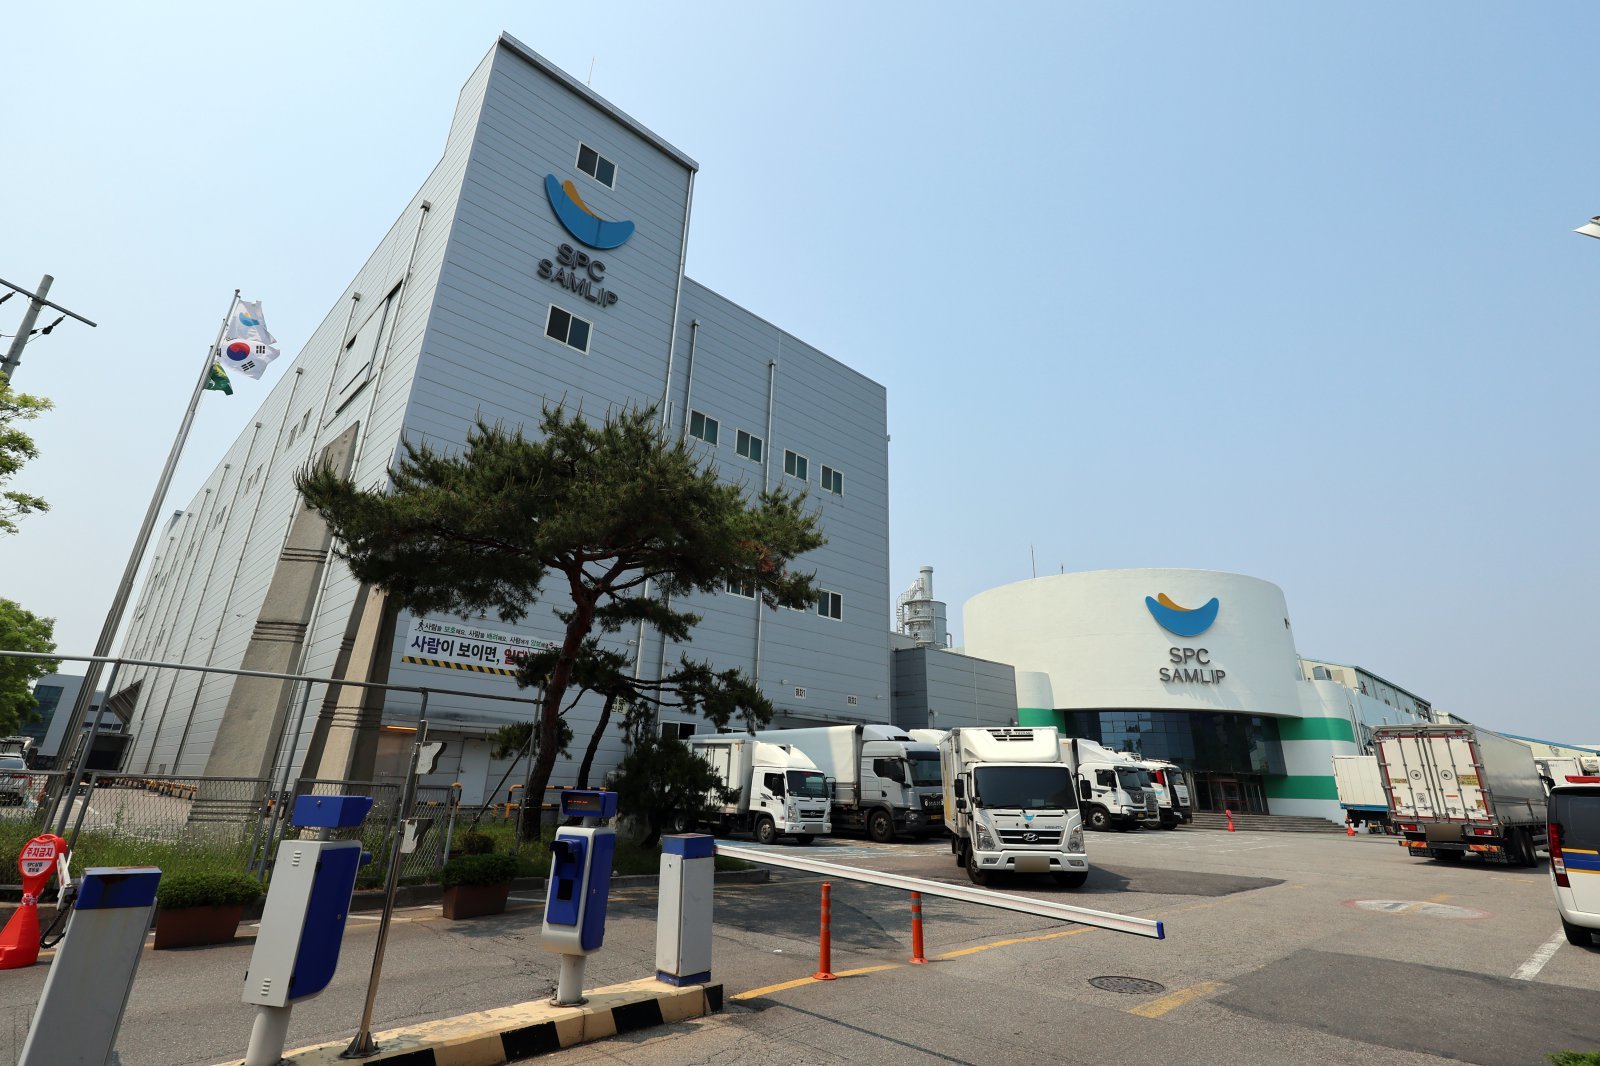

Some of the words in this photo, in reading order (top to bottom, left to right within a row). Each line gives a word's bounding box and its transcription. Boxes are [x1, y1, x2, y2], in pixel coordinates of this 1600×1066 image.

[557, 243, 606, 282] SPC
[537, 258, 618, 308] SAMLIP
[424, 622, 442, 631] 사람을
[468, 629, 485, 639] 사람을
[411, 635, 455, 657] 사람이
[456, 642, 500, 665] 보이면,
[1169, 647, 1211, 665] SPC
[1159, 667, 1226, 684] SAMLIP
[26, 847, 54, 857] 주차금지
